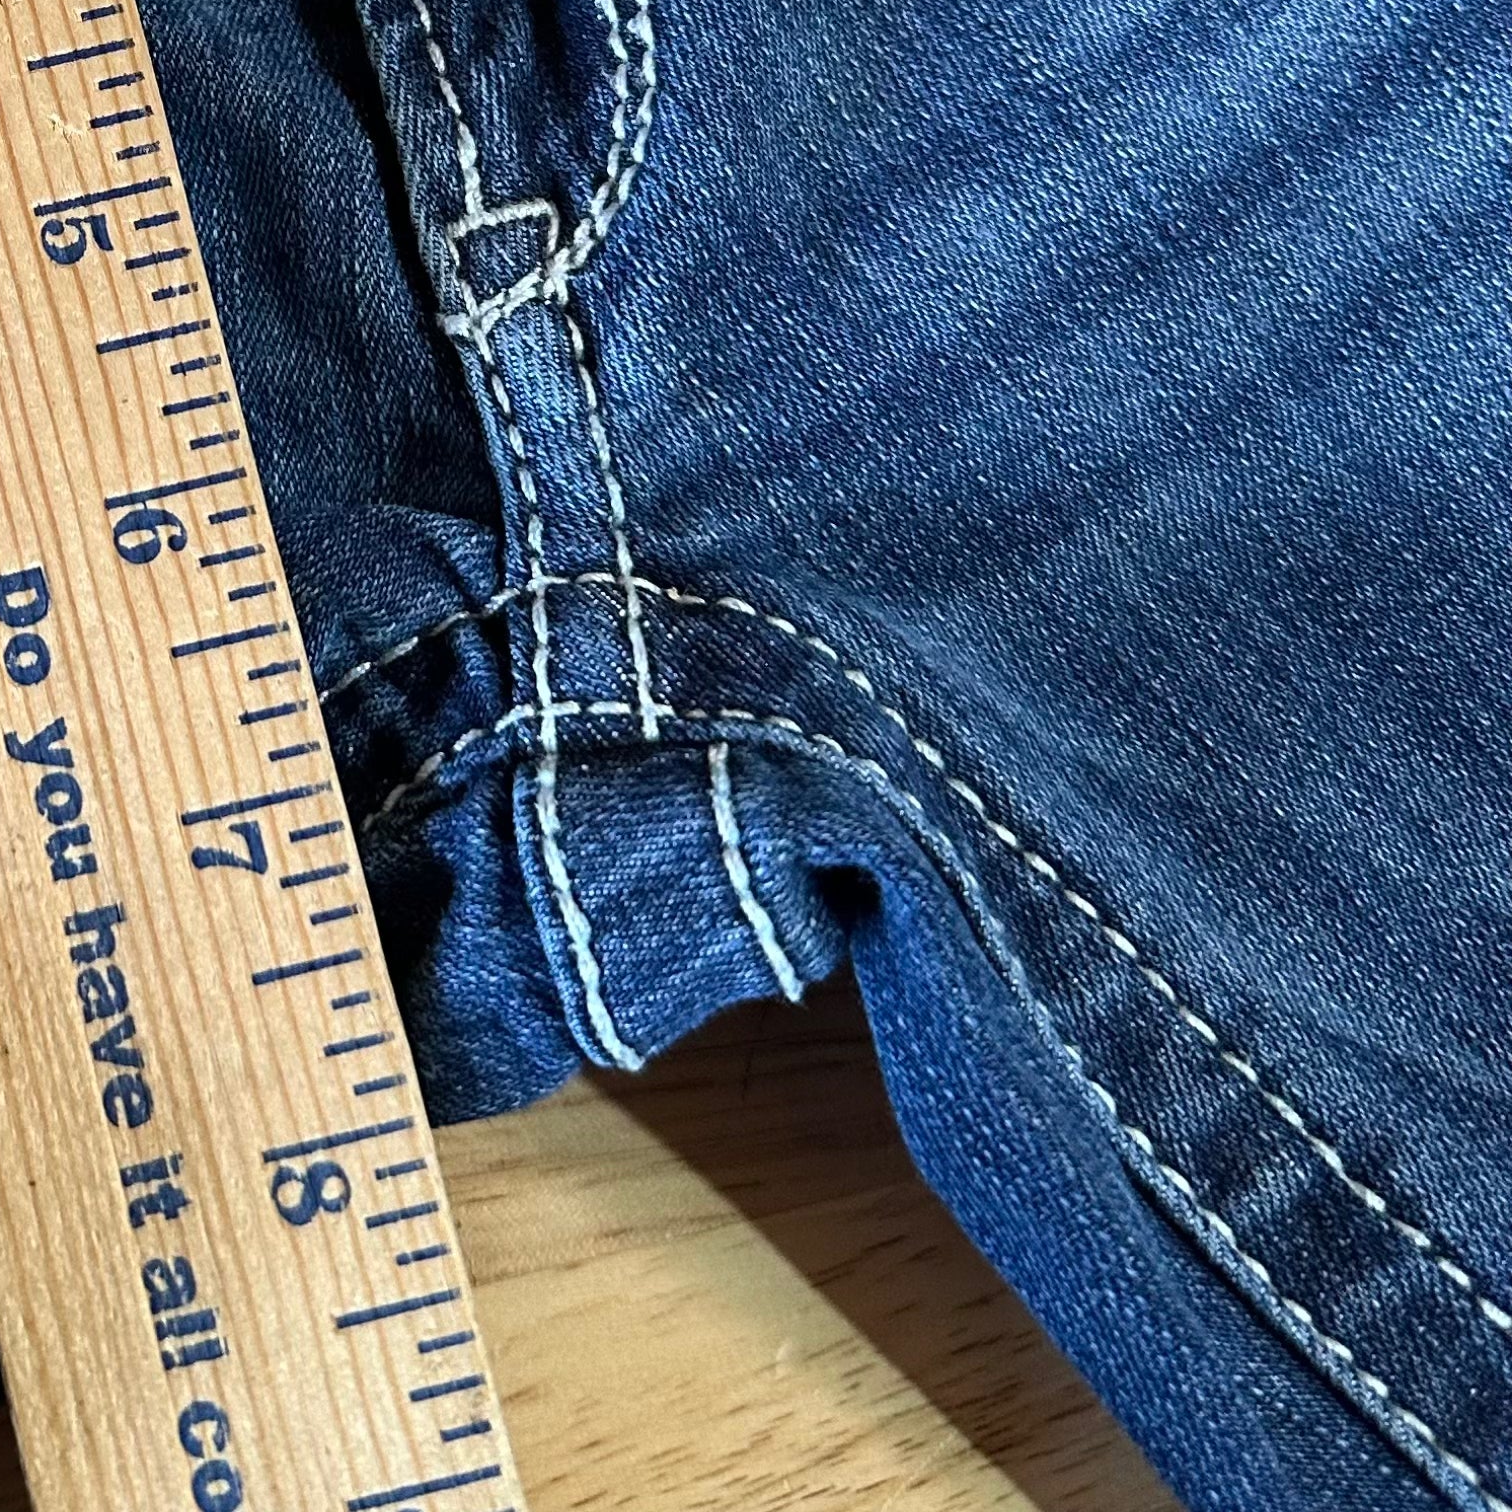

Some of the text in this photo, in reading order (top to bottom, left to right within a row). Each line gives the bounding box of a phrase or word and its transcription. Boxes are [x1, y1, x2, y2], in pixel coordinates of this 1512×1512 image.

[4, 716, 98, 881] you
[41, 213, 114, 266] 5
[113, 503, 188, 565] 6
[192, 820, 268, 875] 7
[270, 1159, 351, 1226] 8
[64, 902, 154, 1129] have
[119, 1151, 192, 1229] it
[141, 1254, 229, 1372] all
